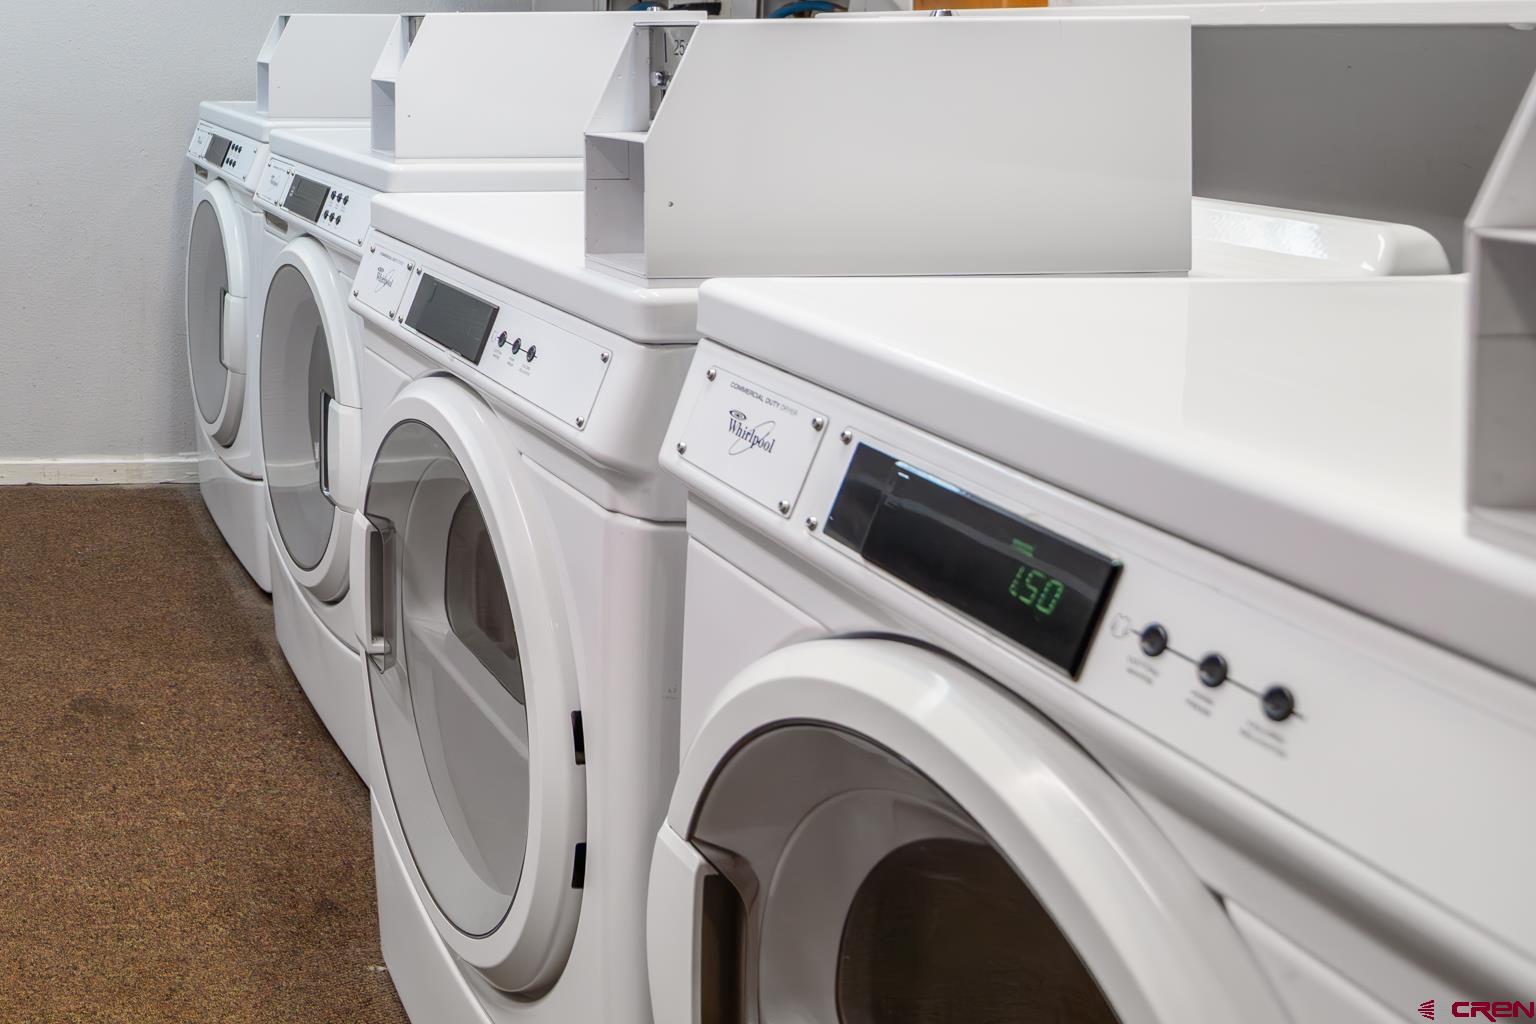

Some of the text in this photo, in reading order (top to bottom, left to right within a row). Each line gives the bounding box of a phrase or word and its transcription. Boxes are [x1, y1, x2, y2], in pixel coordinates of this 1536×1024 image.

[730, 382, 764, 402] COMMERCIAL
[765, 397, 780, 408] DUTY
[728, 418, 776, 454] Whirlpool
